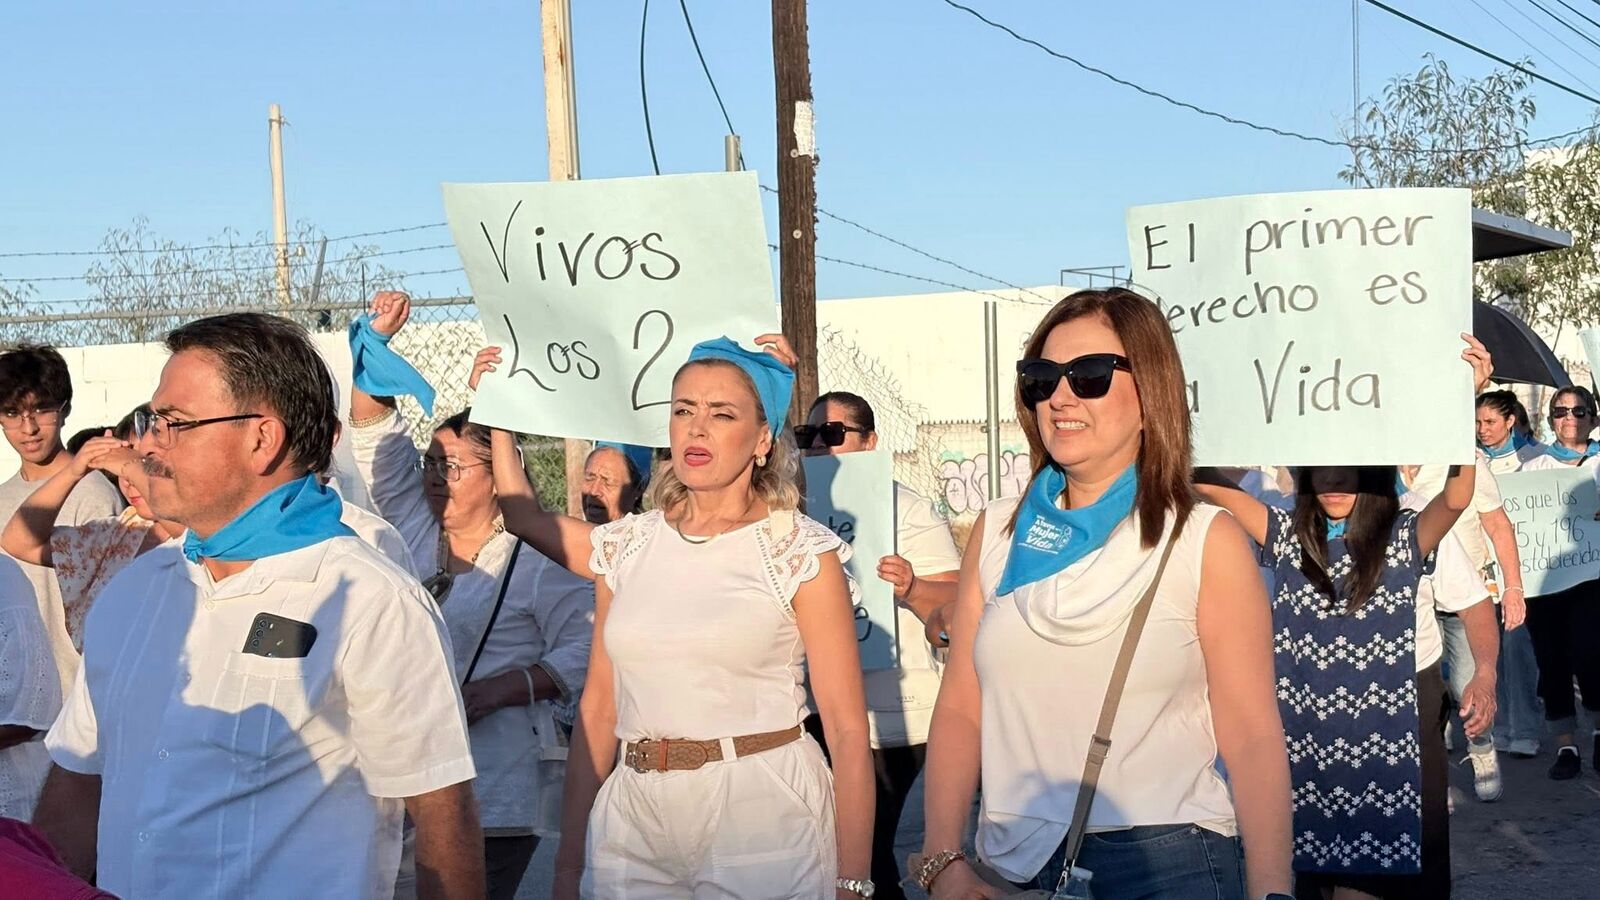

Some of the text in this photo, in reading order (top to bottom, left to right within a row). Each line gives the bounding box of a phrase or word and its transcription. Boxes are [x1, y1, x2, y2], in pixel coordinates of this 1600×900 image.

[480, 199, 681, 287] Vivos
[1143, 207, 1434, 276] El primer
[1156, 270, 1429, 335] erecho es
[503, 309, 673, 411] Los 2
[1253, 340, 1381, 425] Vida
[1503, 479, 1578, 523] os que los
[1025, 534, 1054, 549] Vida
[1028, 524, 1060, 540] Mujer
[1512, 515, 1585, 558] 5 y 196
[1519, 541, 1600, 573] stablecida
